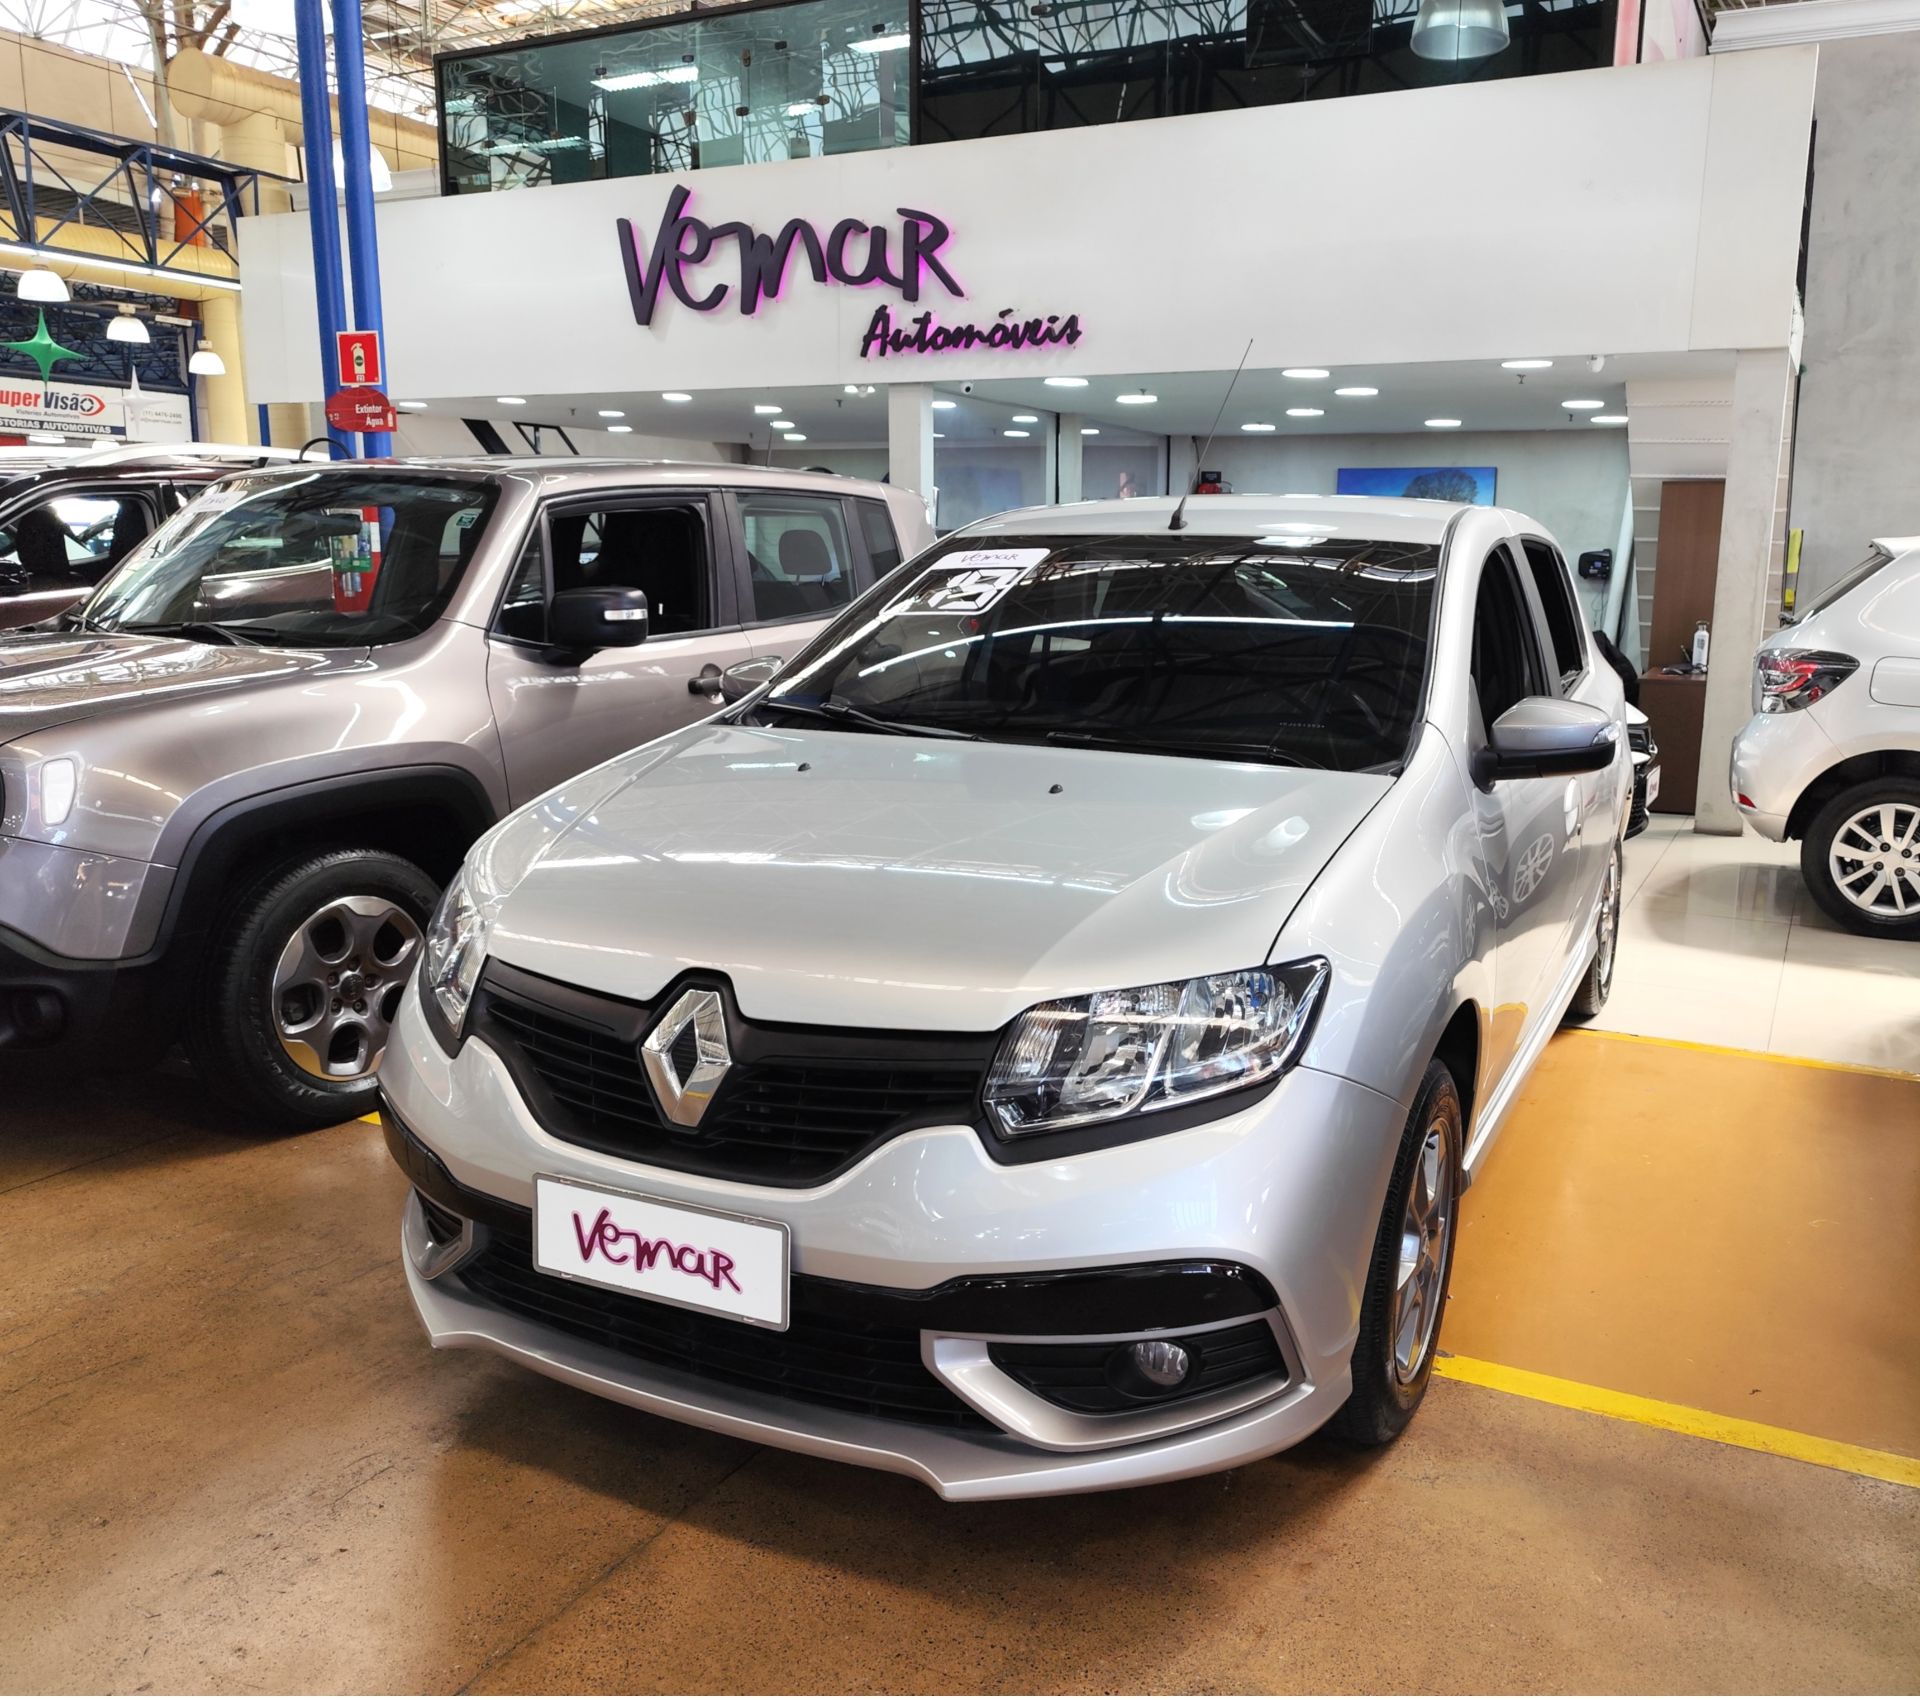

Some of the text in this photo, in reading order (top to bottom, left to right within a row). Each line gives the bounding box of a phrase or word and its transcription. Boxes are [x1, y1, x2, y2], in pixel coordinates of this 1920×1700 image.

[860, 304, 1082, 357] Automóveis
[355, 404, 382, 414] Extintor
[366, 414, 384, 427] Água
[43, 421, 111, 434] AUTOMOTIVAS
